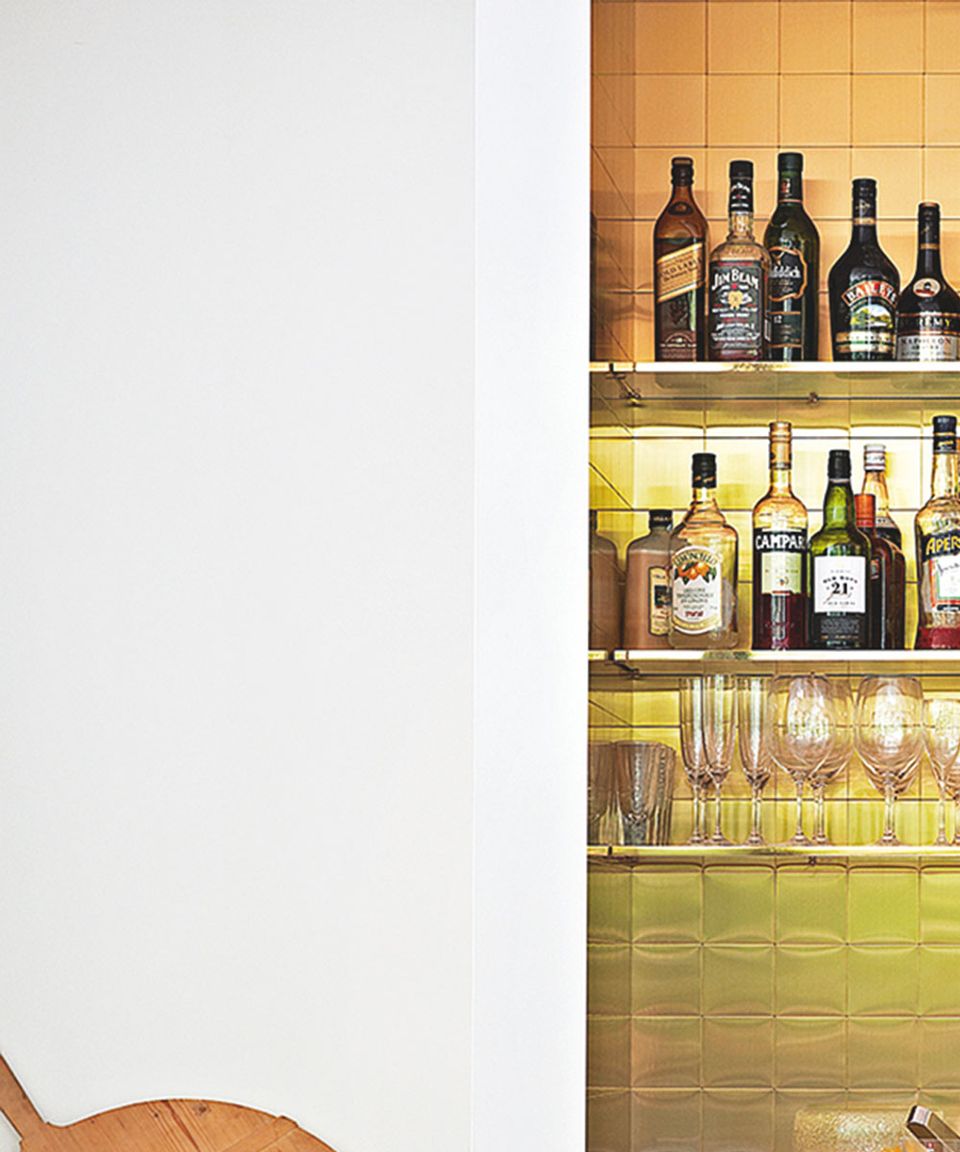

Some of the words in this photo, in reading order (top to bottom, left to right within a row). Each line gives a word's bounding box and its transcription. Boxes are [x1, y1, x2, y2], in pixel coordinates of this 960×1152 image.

[711, 272, 730, 290] JIM
[731, 268, 759, 289] BEAM
[845, 281, 897, 303] BAILEYS
[831, 581, 848, 595] 21
